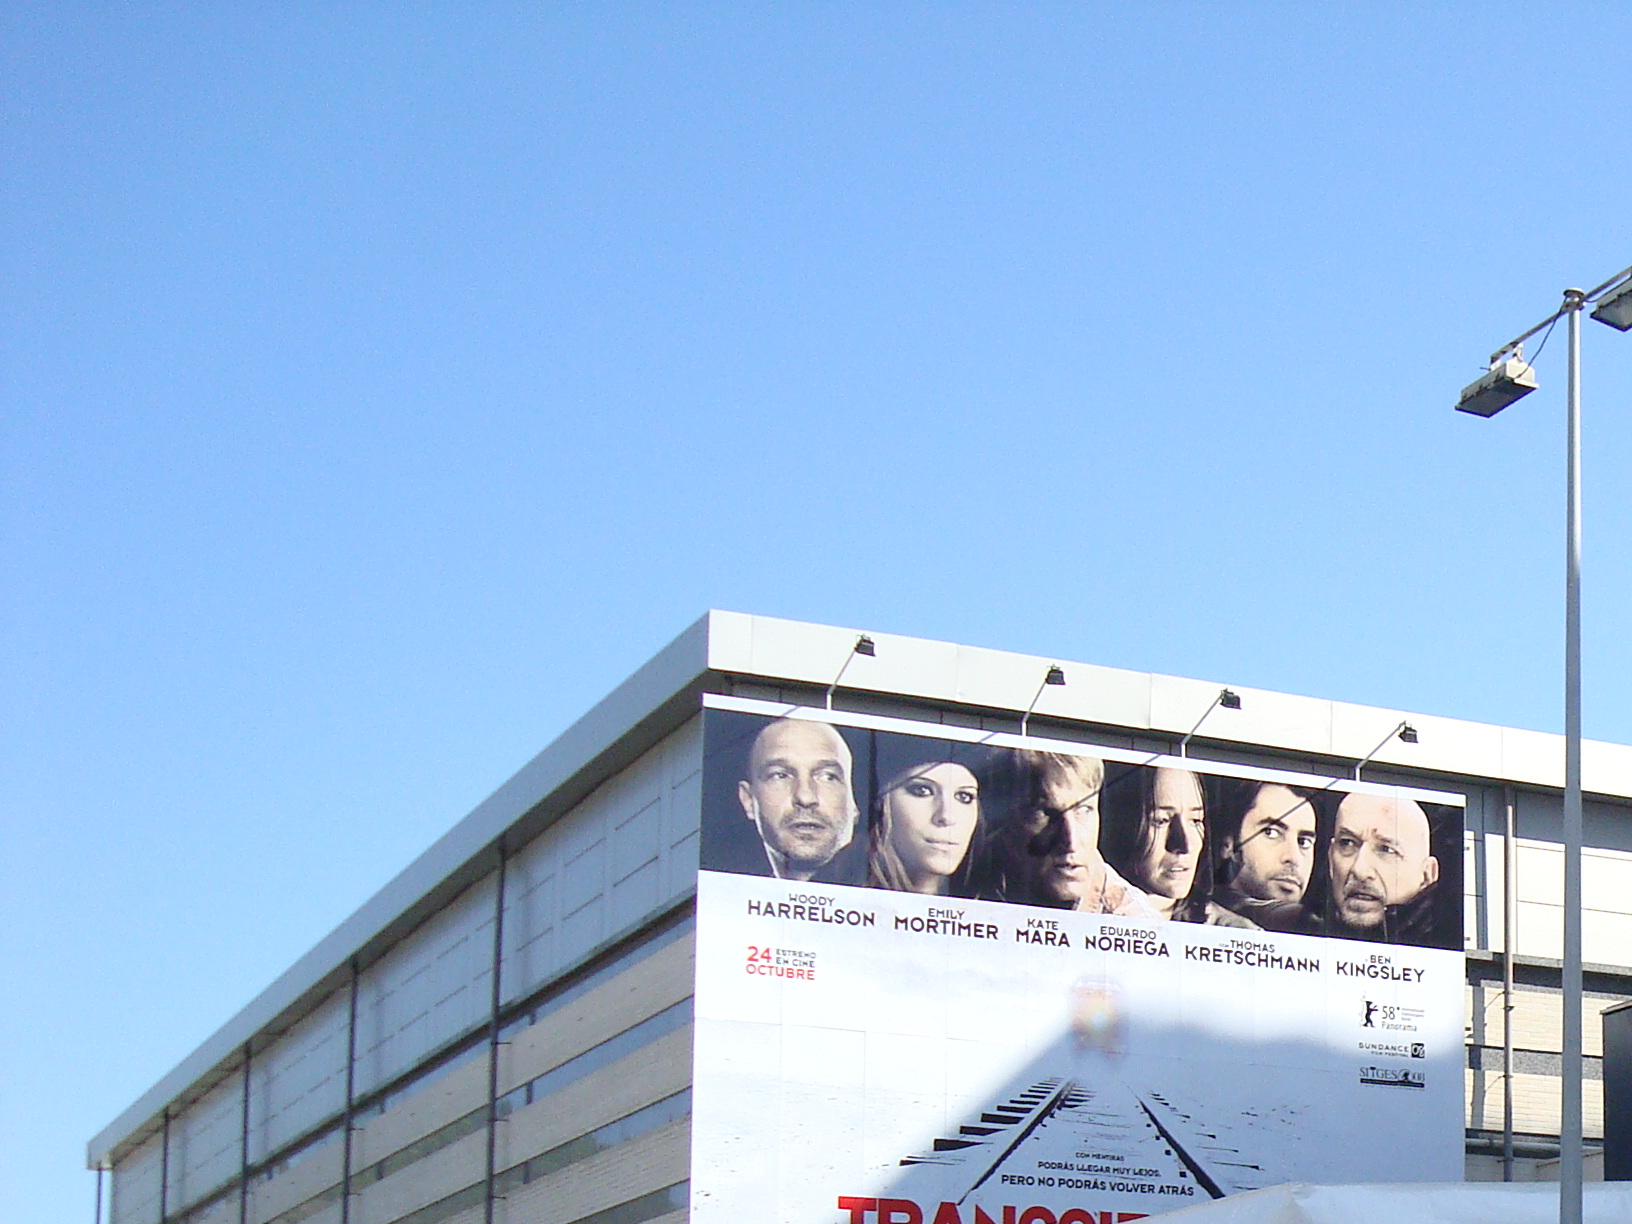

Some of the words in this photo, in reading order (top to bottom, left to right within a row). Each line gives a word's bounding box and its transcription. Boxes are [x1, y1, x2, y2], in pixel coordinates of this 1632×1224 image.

[788, 893, 835, 907] WOODY
[747, 899, 875, 927] HARRELSON
[928, 907, 965, 921] EMILY
[894, 915, 999, 941] MORTIMER
[1027, 918, 1059, 931] KATE
[1015, 928, 1071, 948] MARA
[1100, 925, 1157, 940] EDUARDO
[1085, 935, 1170, 957] NORIEGA
[1230, 939, 1275, 953] THOMAS
[747, 945, 772, 963] 24
[1185, 945, 1321, 973] KRETSCHMANN
[1370, 954, 1392, 965] BEN
[776, 957, 789, 965] EN
[792, 959, 815, 968] CINE
[745, 963, 816, 980] OCTUBRE
[1336, 961, 1425, 983] KINGSLEY
[1381, 1021, 1417, 1032] Panorama
[1358, 1042, 1409, 1053] SUNDANCE
[1359, 1066, 1398, 1080] SITGES
[1038, 1160, 1074, 1171] PODRÁS
[1076, 1163, 1111, 1174] LLEGAR
[1112, 1167, 1130, 1175] MUY
[1001, 1174, 1035, 1186] PERO
[1038, 1176, 1055, 1187] NO
[1058, 1178, 1106, 1191] PODRÁS
[1109, 1181, 1155, 1194] VOLVER
[1158, 1184, 1194, 1196] ATRÁS
